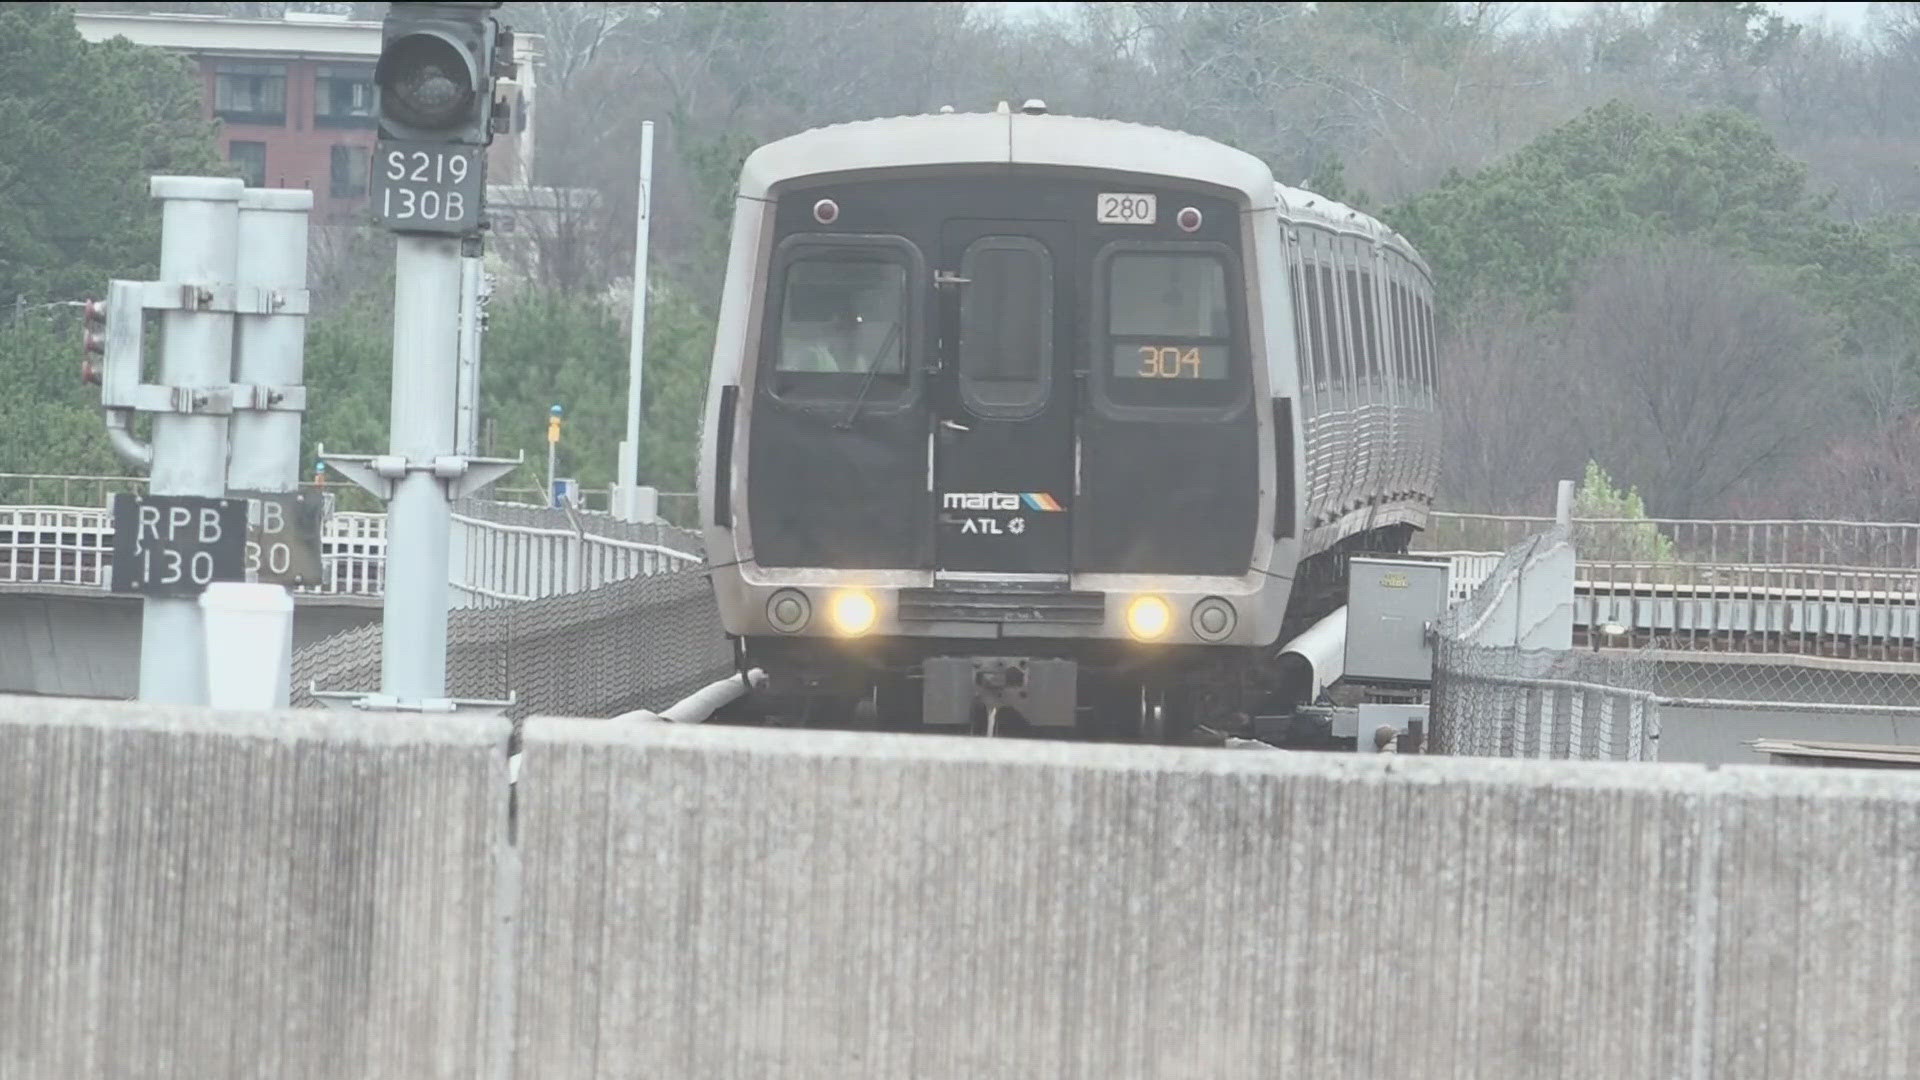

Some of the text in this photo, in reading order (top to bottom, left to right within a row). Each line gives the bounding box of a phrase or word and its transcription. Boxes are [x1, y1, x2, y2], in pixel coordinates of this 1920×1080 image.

[387, 151, 468, 184] S219
[384, 188, 464, 221] 130B
[1105, 197, 1149, 220] 280
[1138, 346, 1200, 378] 304
[943, 491, 1020, 511] marta
[138, 506, 222, 543] RPB
[961, 517, 1004, 535] ATL
[143, 549, 214, 584] 130
